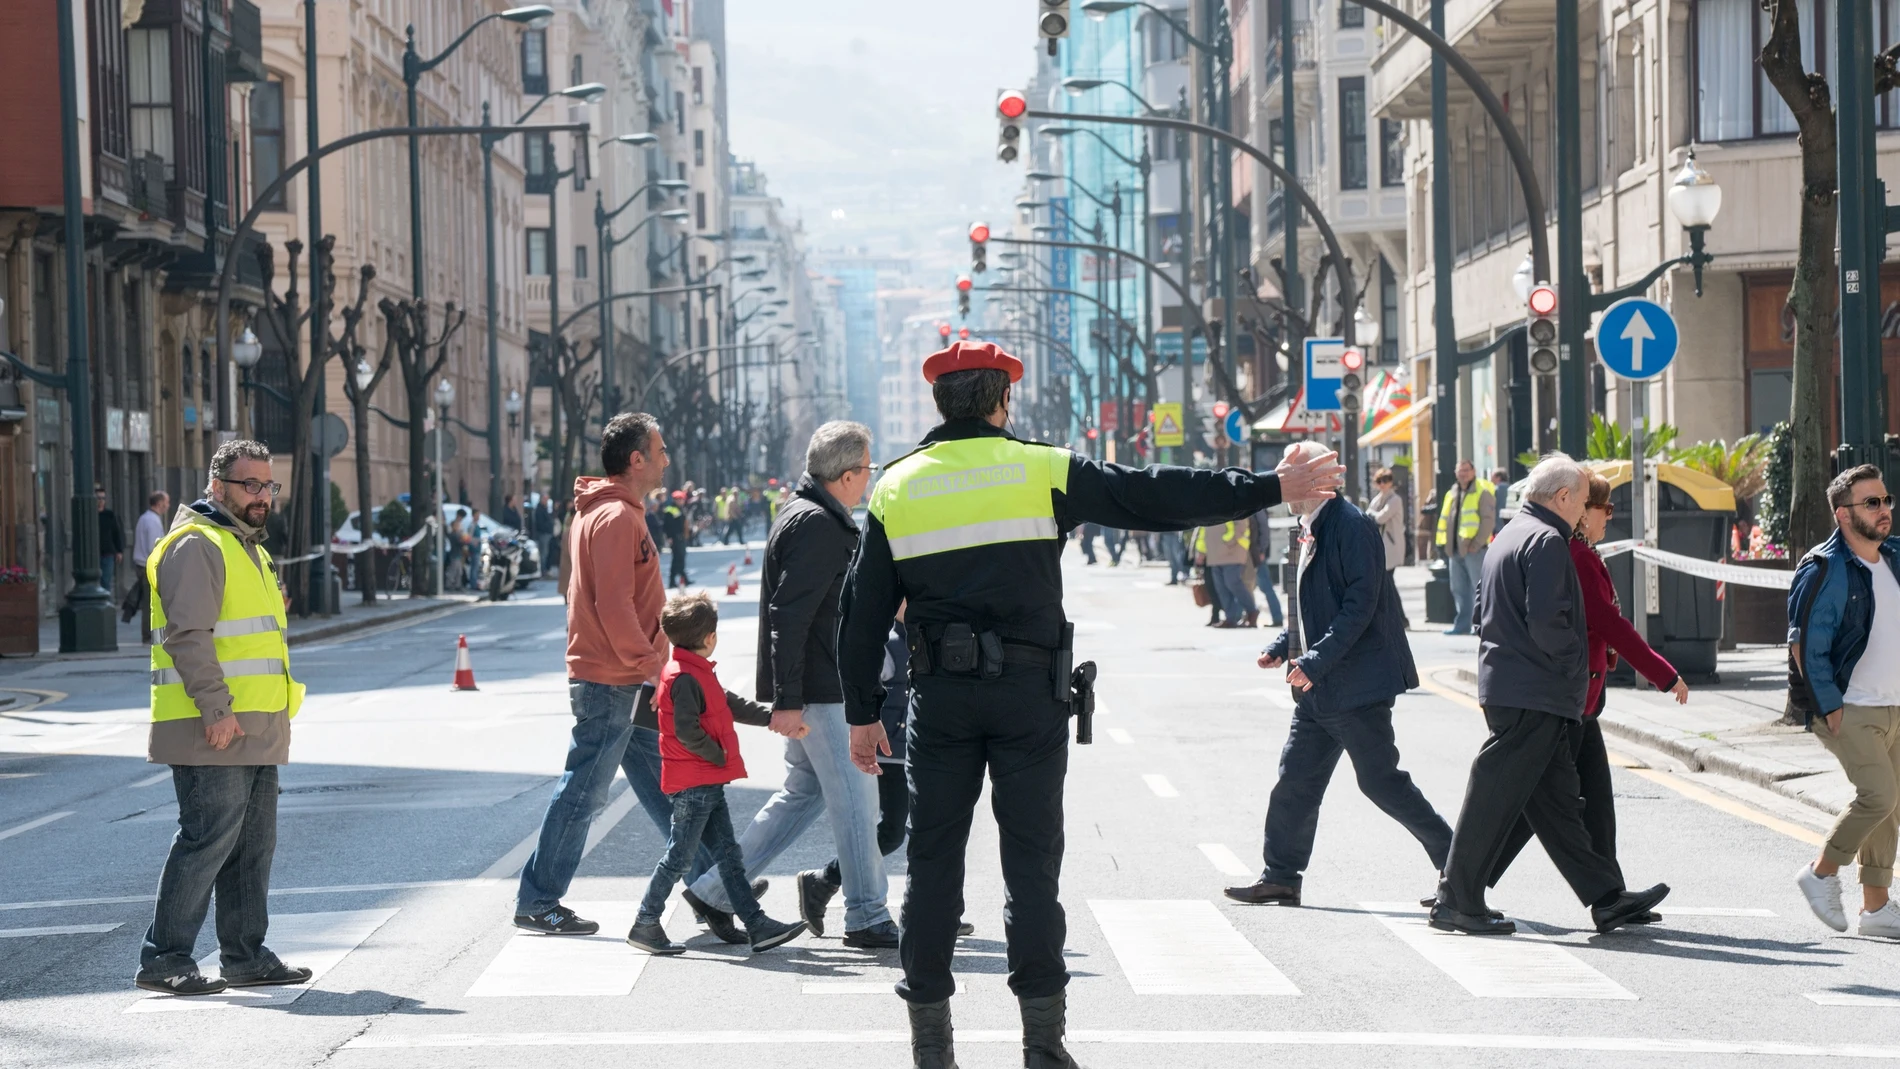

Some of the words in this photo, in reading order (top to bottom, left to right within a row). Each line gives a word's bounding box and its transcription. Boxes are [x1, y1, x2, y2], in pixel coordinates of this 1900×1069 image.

[1847, 284, 1859, 292] 24
[910, 466, 1023, 496] UDALTZAINGOA
[544, 912, 564, 926] N
[163, 975, 188, 988] N
